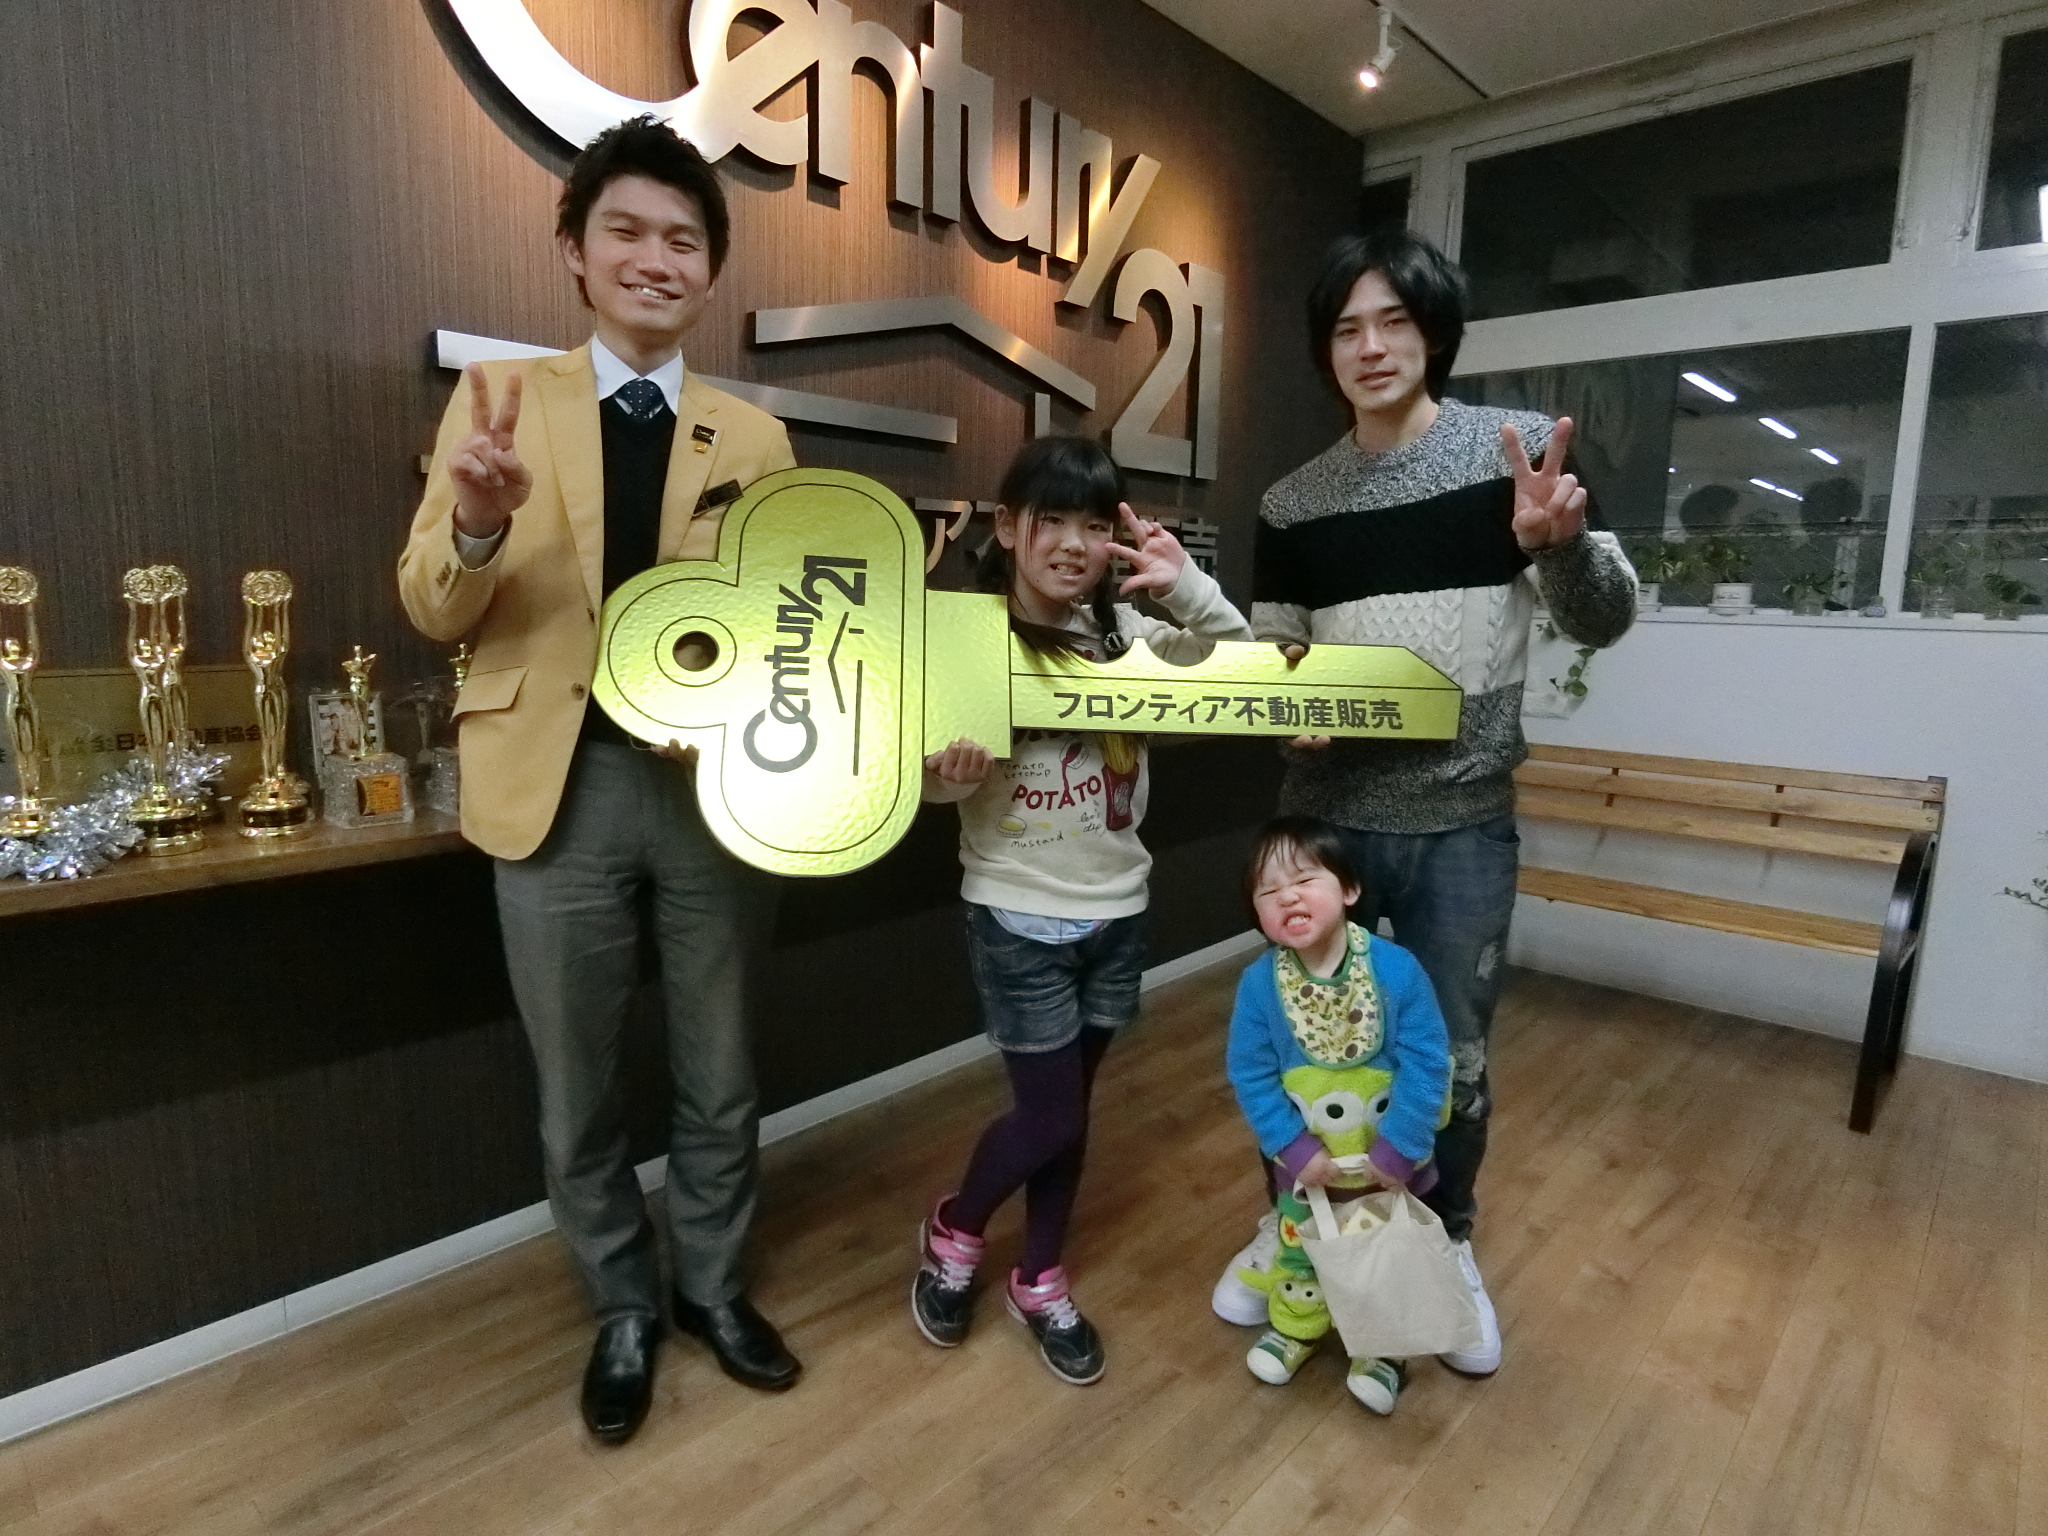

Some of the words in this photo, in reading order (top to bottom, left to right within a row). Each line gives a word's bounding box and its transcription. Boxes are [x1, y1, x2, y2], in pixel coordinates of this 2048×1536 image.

[1110, 247, 1226, 480] 21
[743, 584, 823, 773] Century
[801, 555, 867, 606] 21
[1053, 691, 1404, 731] フロンティア不動産販売
[1011, 775, 1102, 810] POTATO
